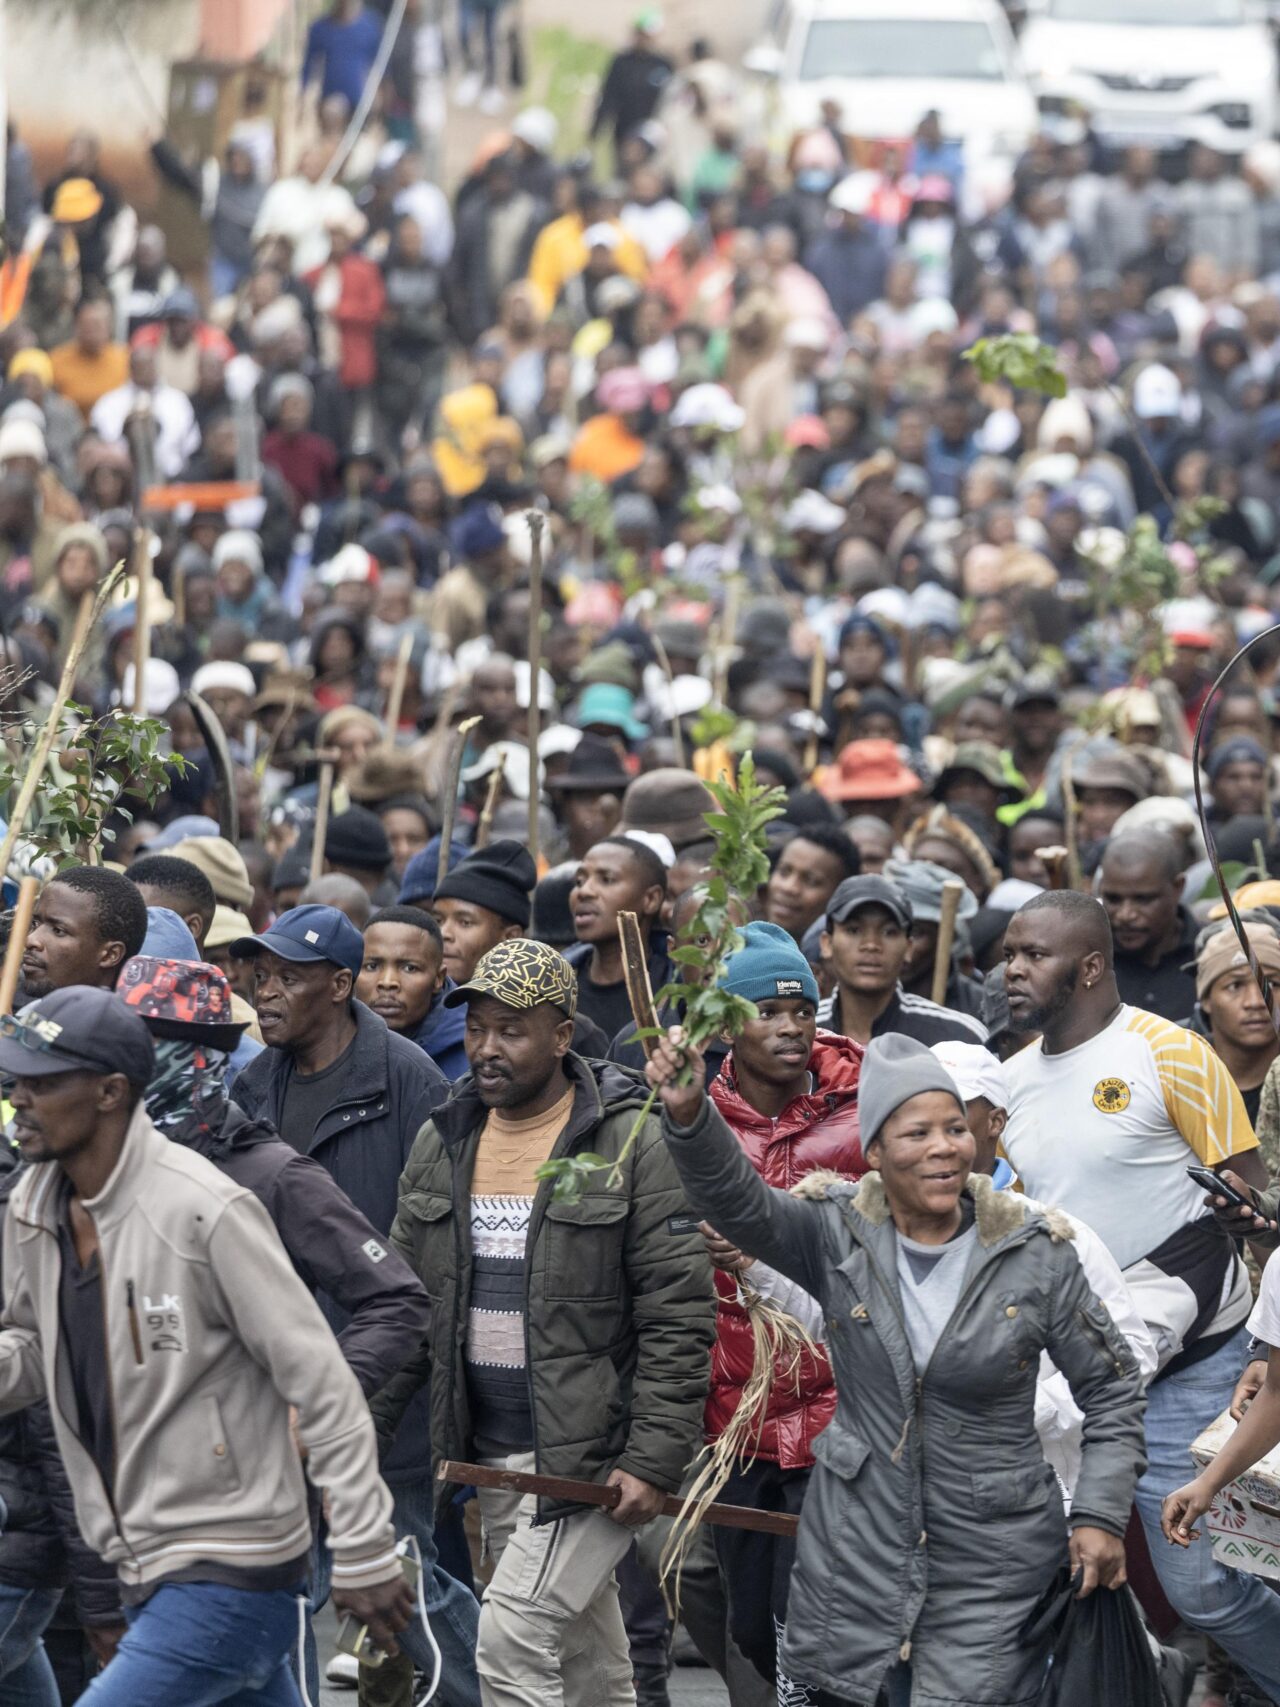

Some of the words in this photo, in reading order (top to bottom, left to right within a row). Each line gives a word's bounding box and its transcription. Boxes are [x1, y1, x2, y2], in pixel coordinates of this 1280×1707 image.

[1101, 1079, 1126, 1091] KAIZER
[1097, 1098, 1122, 1110] CHIEFS
[143, 1293, 180, 1313] LK
